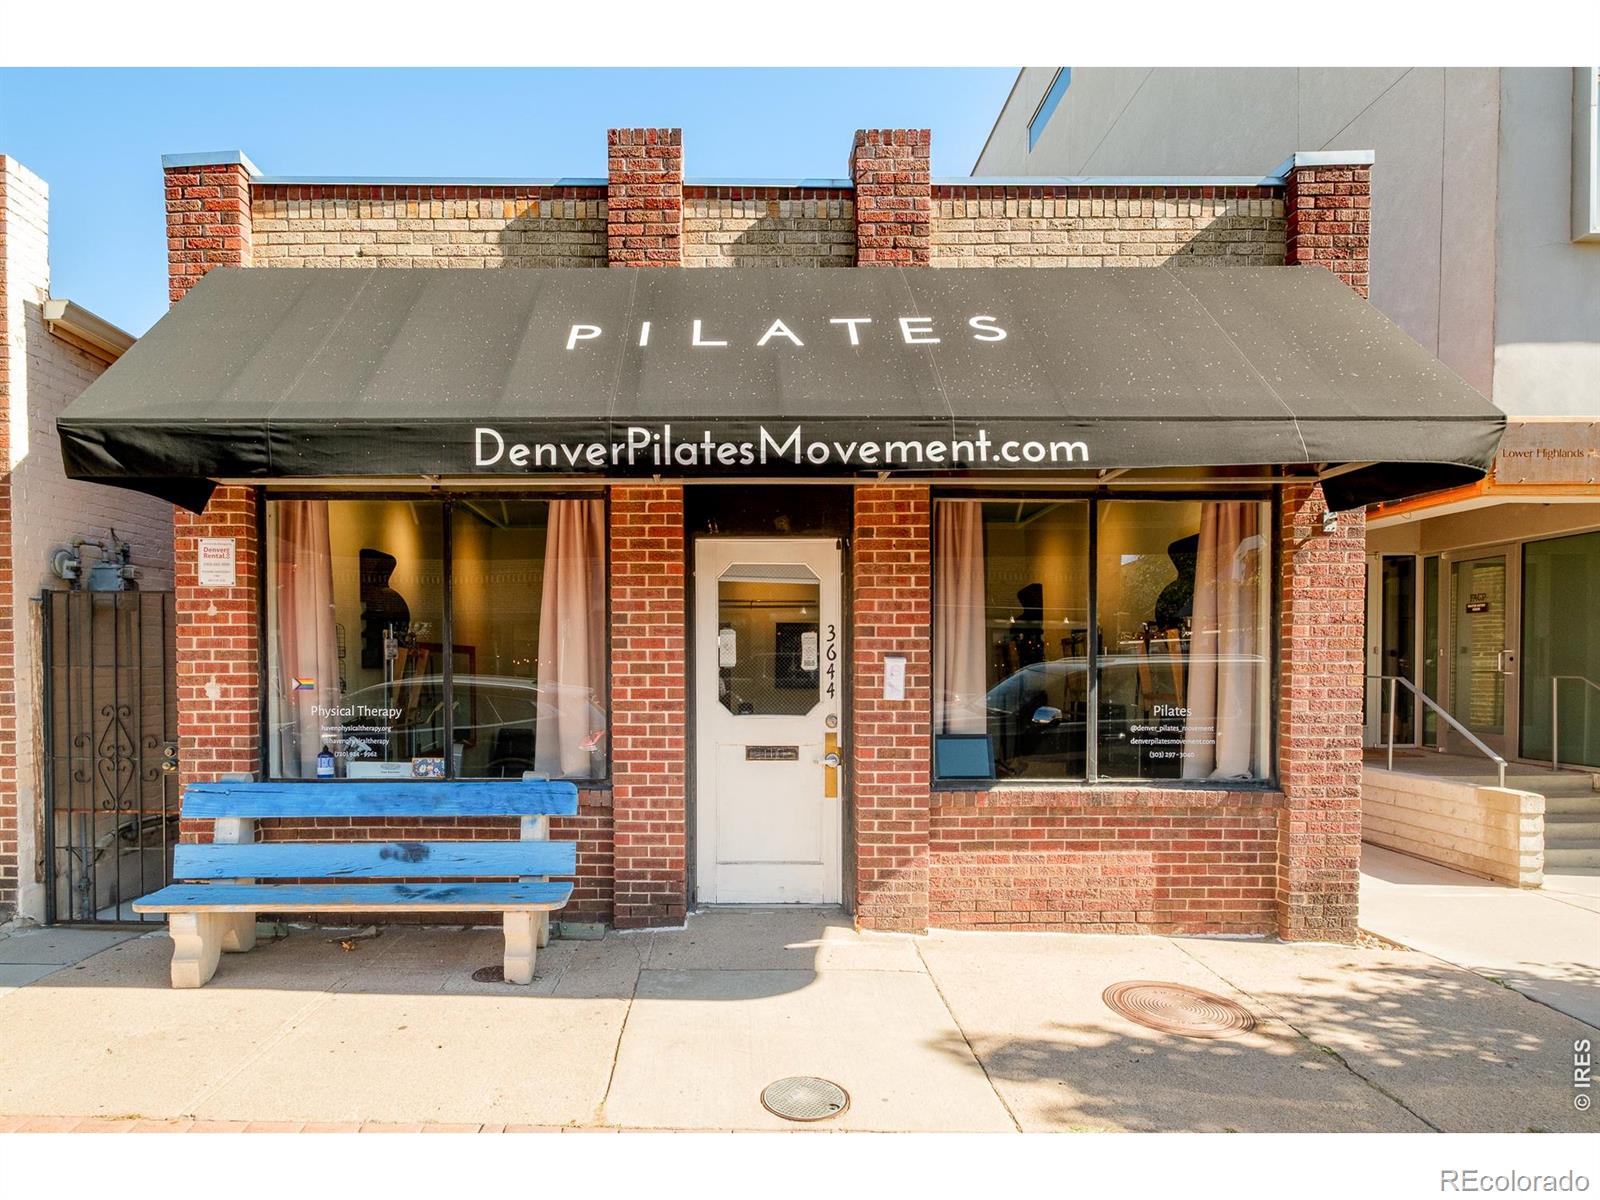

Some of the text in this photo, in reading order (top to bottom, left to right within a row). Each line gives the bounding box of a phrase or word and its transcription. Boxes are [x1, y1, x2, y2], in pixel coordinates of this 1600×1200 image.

[566, 315, 1008, 350] PILATES
[475, 424, 1089, 467] DenverPilatesMovement.com
[1502, 448, 1585, 461] Lower Highlands
[826, 624, 837, 699] 3644
[310, 705, 403, 719] Physical Therapy
[1153, 704, 1193, 717] Pilates
[321, 725, 392, 733] havenphysicaltherapy.org
[1130, 724, 1215, 733] @denver_pilates_movement
[1130, 738, 1216, 746] denverpilatesmovement.com
